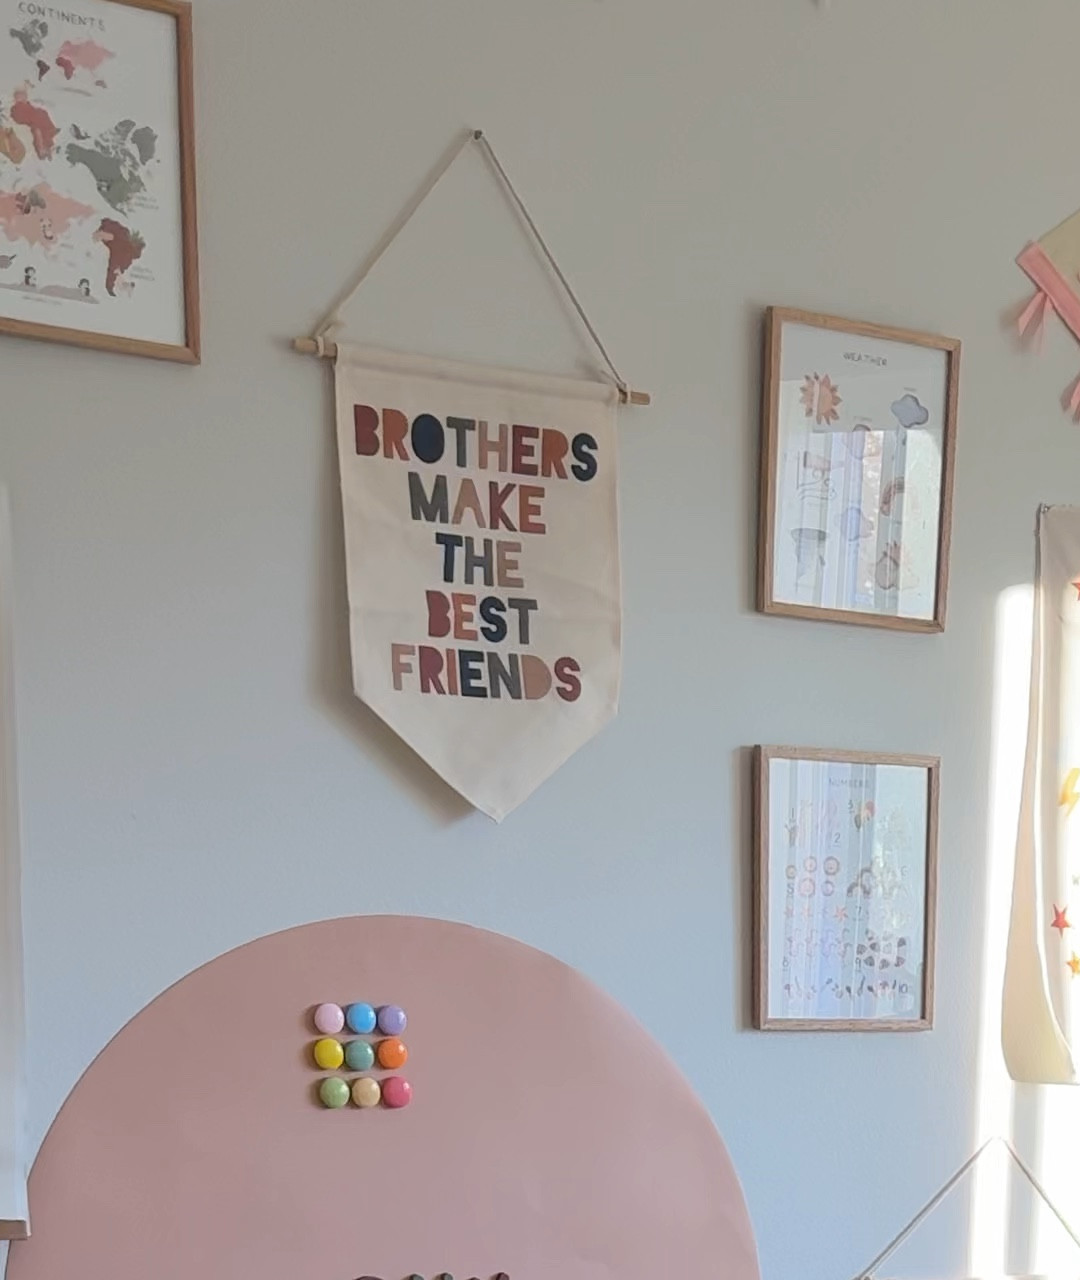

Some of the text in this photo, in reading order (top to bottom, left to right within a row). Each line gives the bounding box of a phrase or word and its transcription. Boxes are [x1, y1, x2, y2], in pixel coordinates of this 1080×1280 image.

[18, 2, 105, 31] CONTINENTS
[353, 403, 599, 482] BROTHERS
[408, 471, 546, 534] MAKE
[435, 532, 524, 589] THE
[426, 589, 539, 645] BEST
[391, 643, 582, 702] FRIENDS
[834, 832, 841, 843] 2
